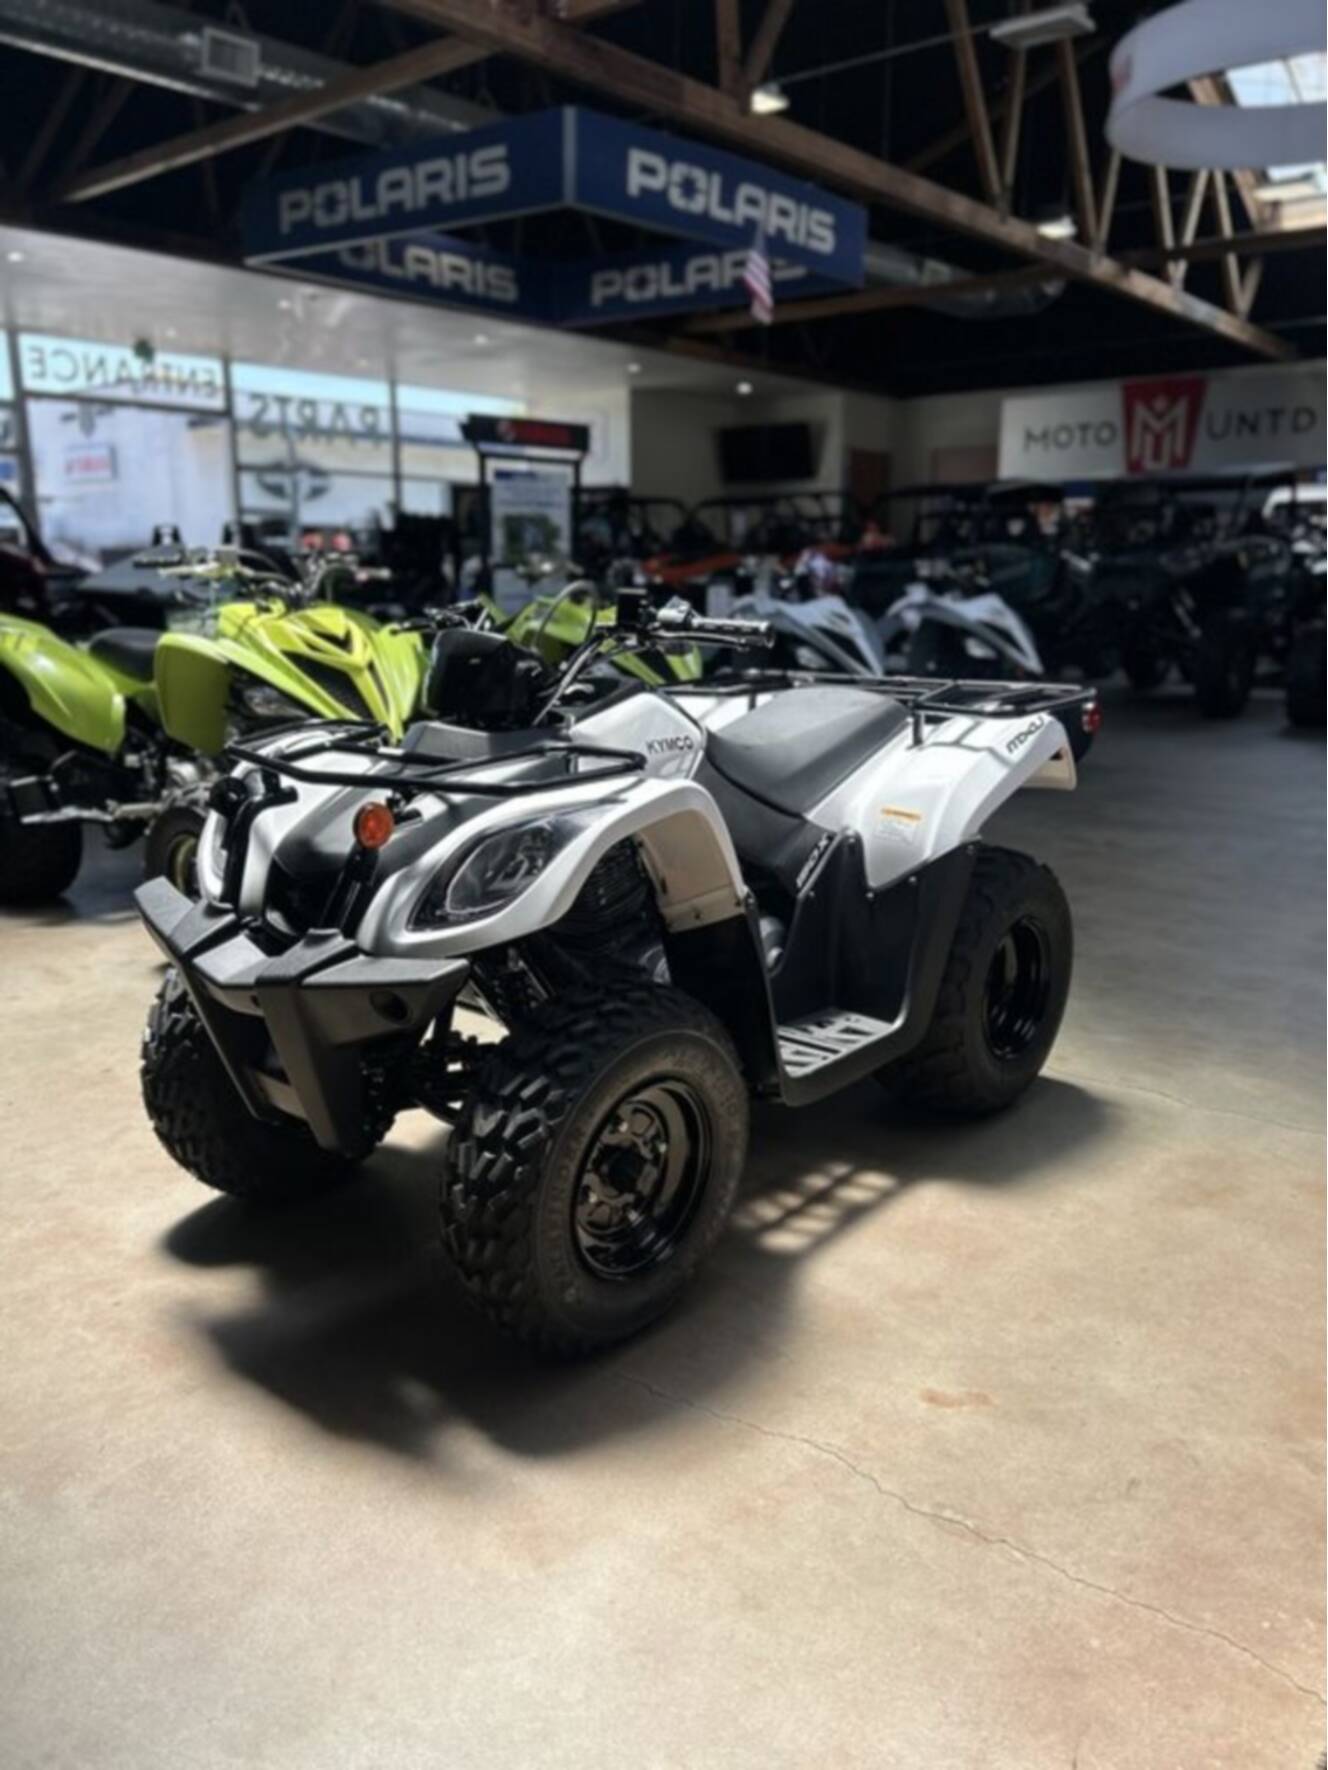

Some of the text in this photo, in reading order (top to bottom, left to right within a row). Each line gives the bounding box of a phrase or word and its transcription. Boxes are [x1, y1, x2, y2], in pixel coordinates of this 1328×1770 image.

[279, 145, 512, 234] POLARIS
[626, 146, 837, 255] POLARIS
[338, 237, 519, 303] OLARIS
[1023, 420, 1119, 452] MOTO
[1206, 406, 1318, 442] UNTD
[645, 735, 694, 755] KYMCO
